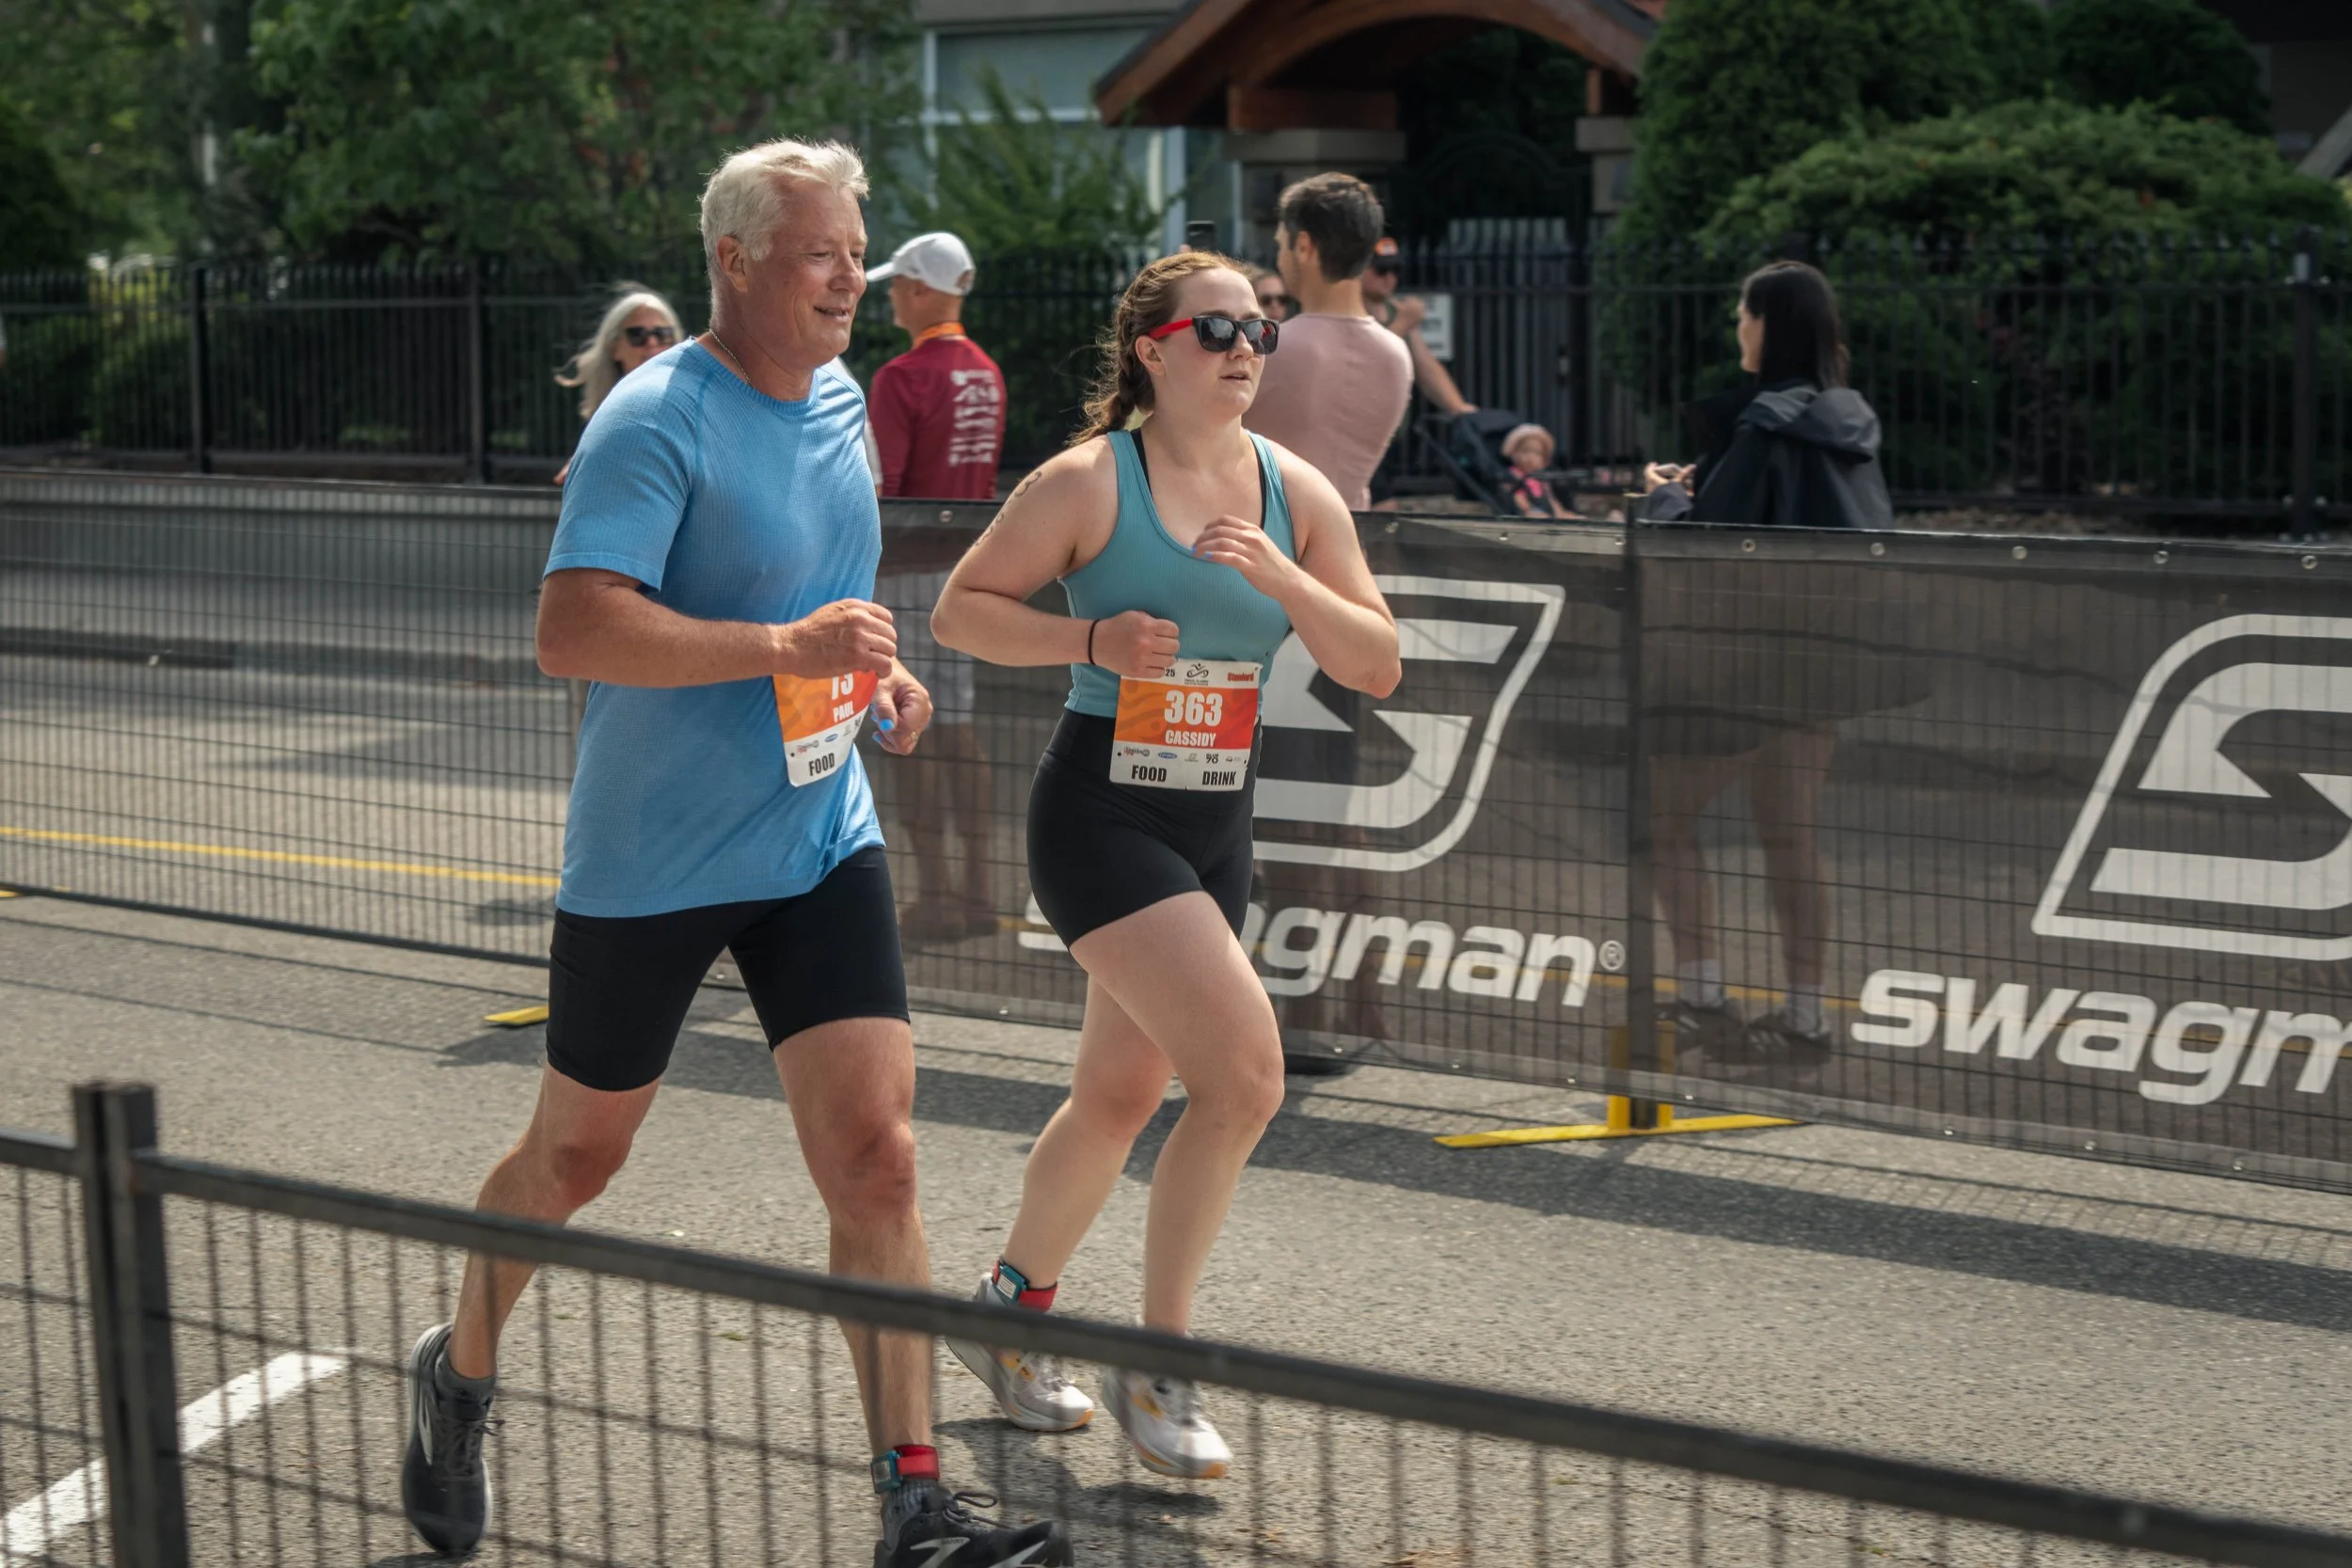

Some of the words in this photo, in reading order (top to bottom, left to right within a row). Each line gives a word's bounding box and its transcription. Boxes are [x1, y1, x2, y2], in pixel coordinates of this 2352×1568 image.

[833, 701, 854, 723] PAUL
[1164, 689, 1223, 726] 363
[1165, 729, 1216, 747] CASSIDY
[808, 752, 835, 777] FOOD
[1131, 765, 1168, 783] FOOD
[1201, 770, 1237, 786] DRINK
